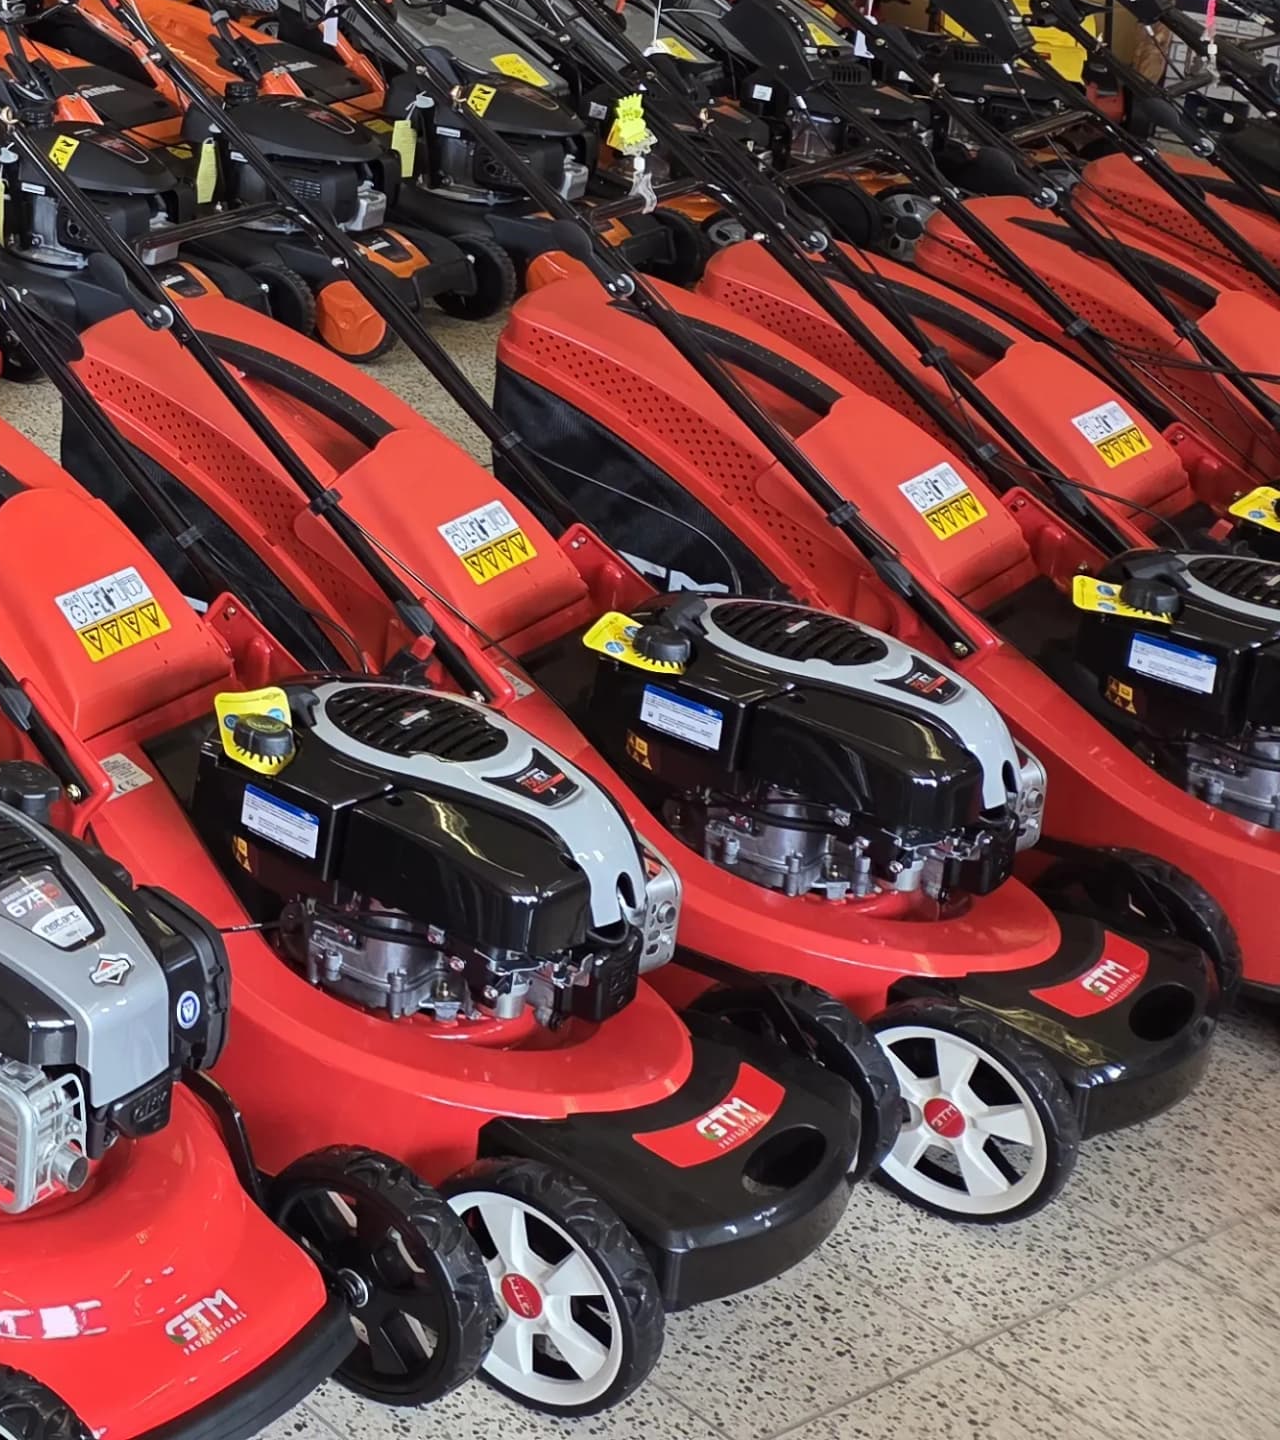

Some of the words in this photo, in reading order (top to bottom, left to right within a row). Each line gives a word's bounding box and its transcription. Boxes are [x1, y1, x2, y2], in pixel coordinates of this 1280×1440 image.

[1082, 958, 1131, 994] GTM
[696, 1096, 758, 1138] GTM
[164, 1288, 239, 1343] GTM
